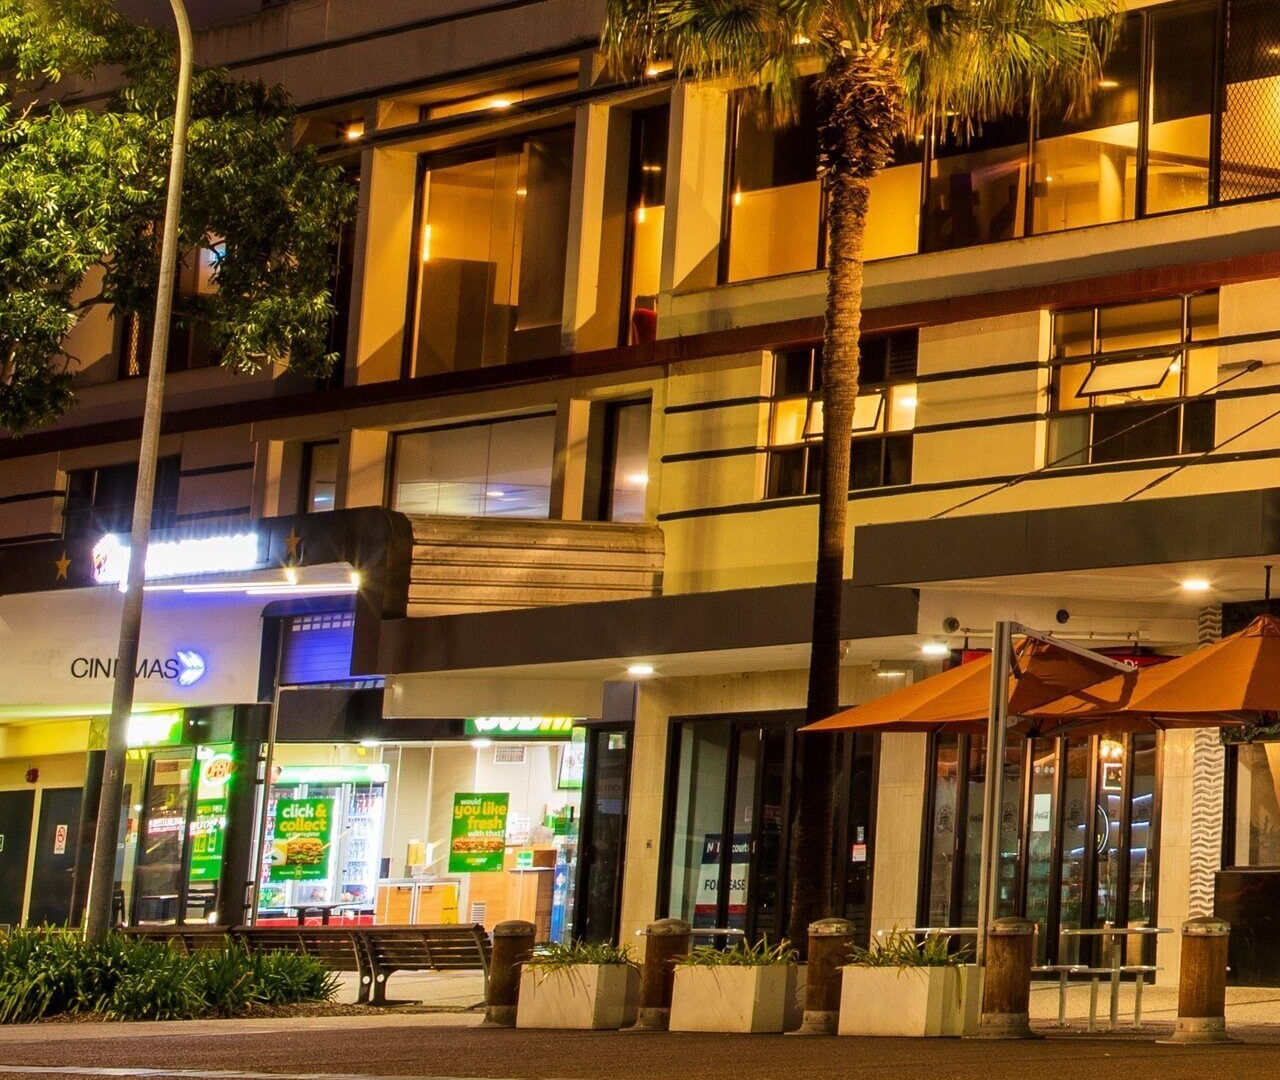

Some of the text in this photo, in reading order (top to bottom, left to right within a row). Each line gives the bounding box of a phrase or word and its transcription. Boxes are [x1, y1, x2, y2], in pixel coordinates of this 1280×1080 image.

[71, 658, 179, 679] CINMAS
[282, 803, 327, 818] click &
[454, 801, 507, 819] you like
[279, 816, 327, 832] collect
[467, 815, 503, 829] fresh
[467, 829, 485, 837] with
[730, 879, 746, 891] EASE
